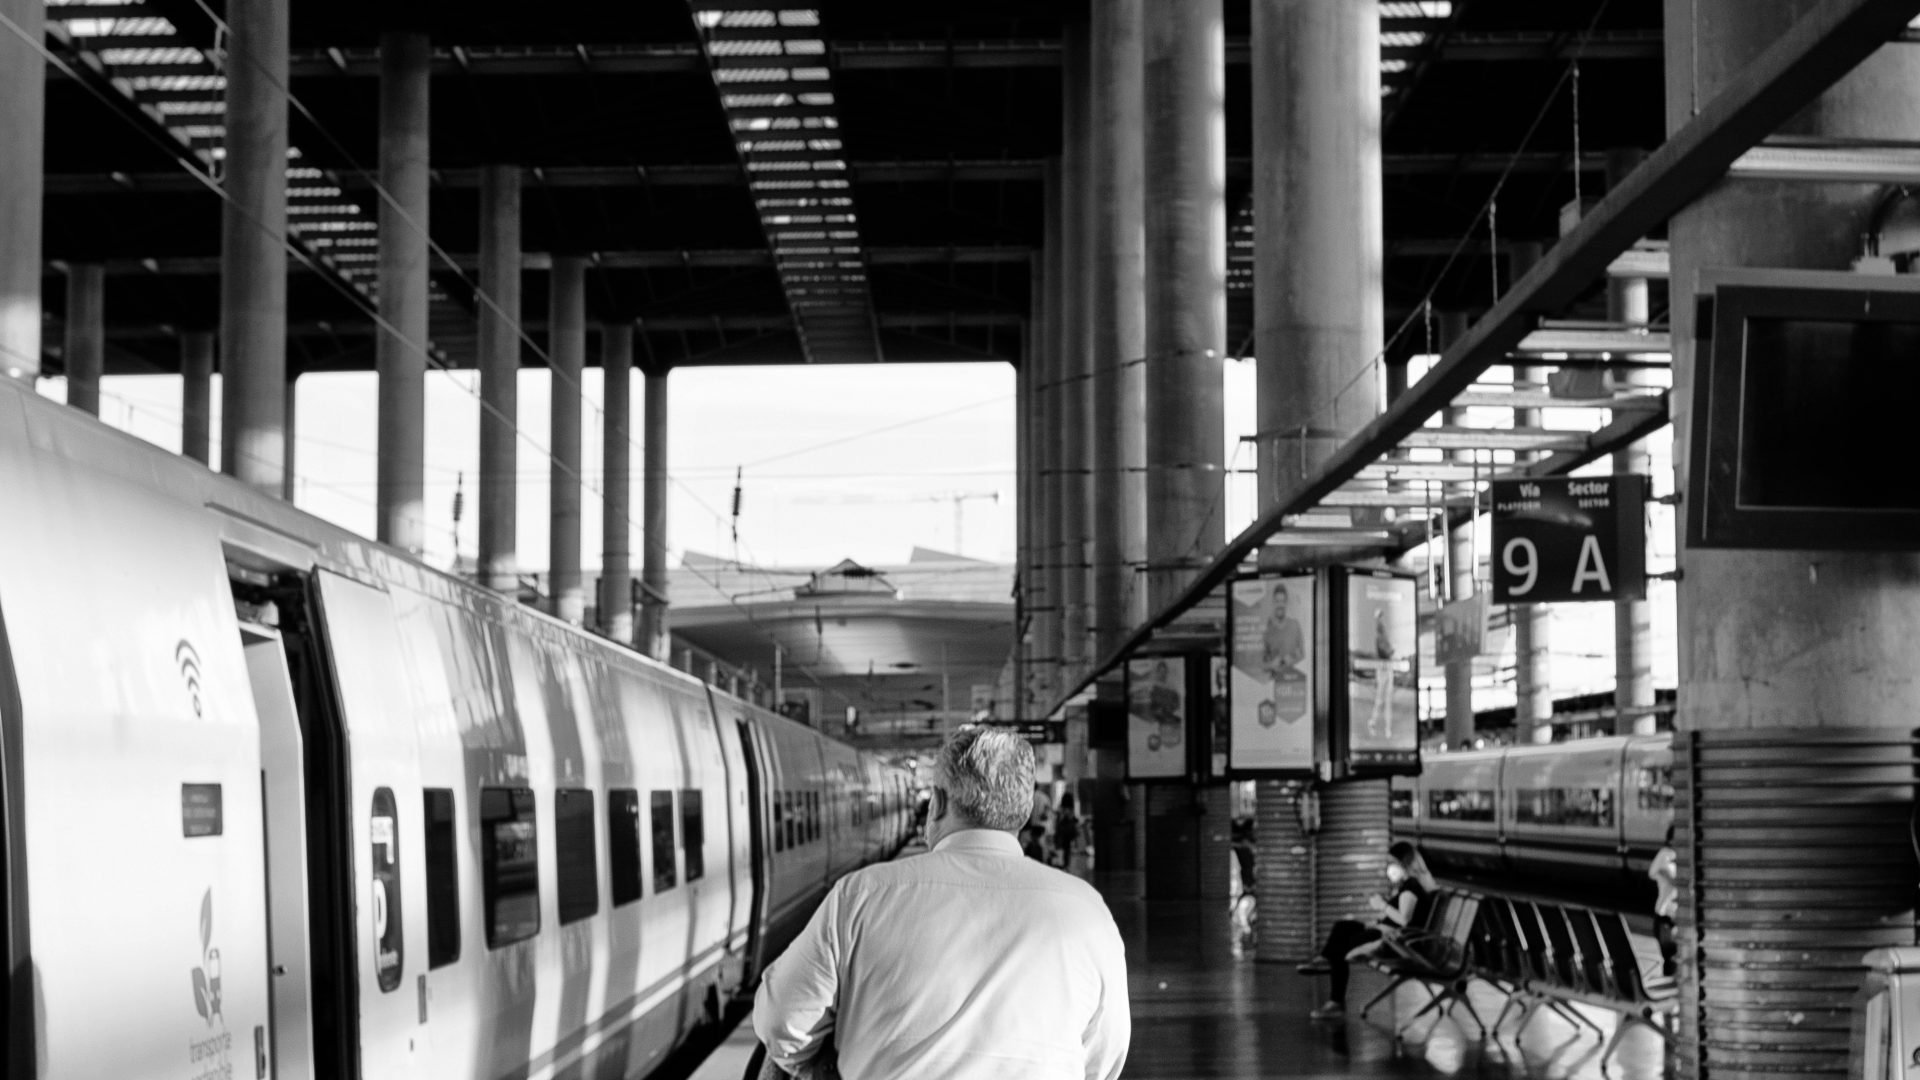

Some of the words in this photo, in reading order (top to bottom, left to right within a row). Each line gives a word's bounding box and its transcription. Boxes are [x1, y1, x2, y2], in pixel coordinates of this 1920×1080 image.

[1568, 481, 1609, 496] Sector
[1497, 500, 1541, 511] PLATFORM
[1578, 498, 1610, 508] SECTOR
[1503, 537, 1538, 595] 9
[1571, 535, 1611, 593] A
